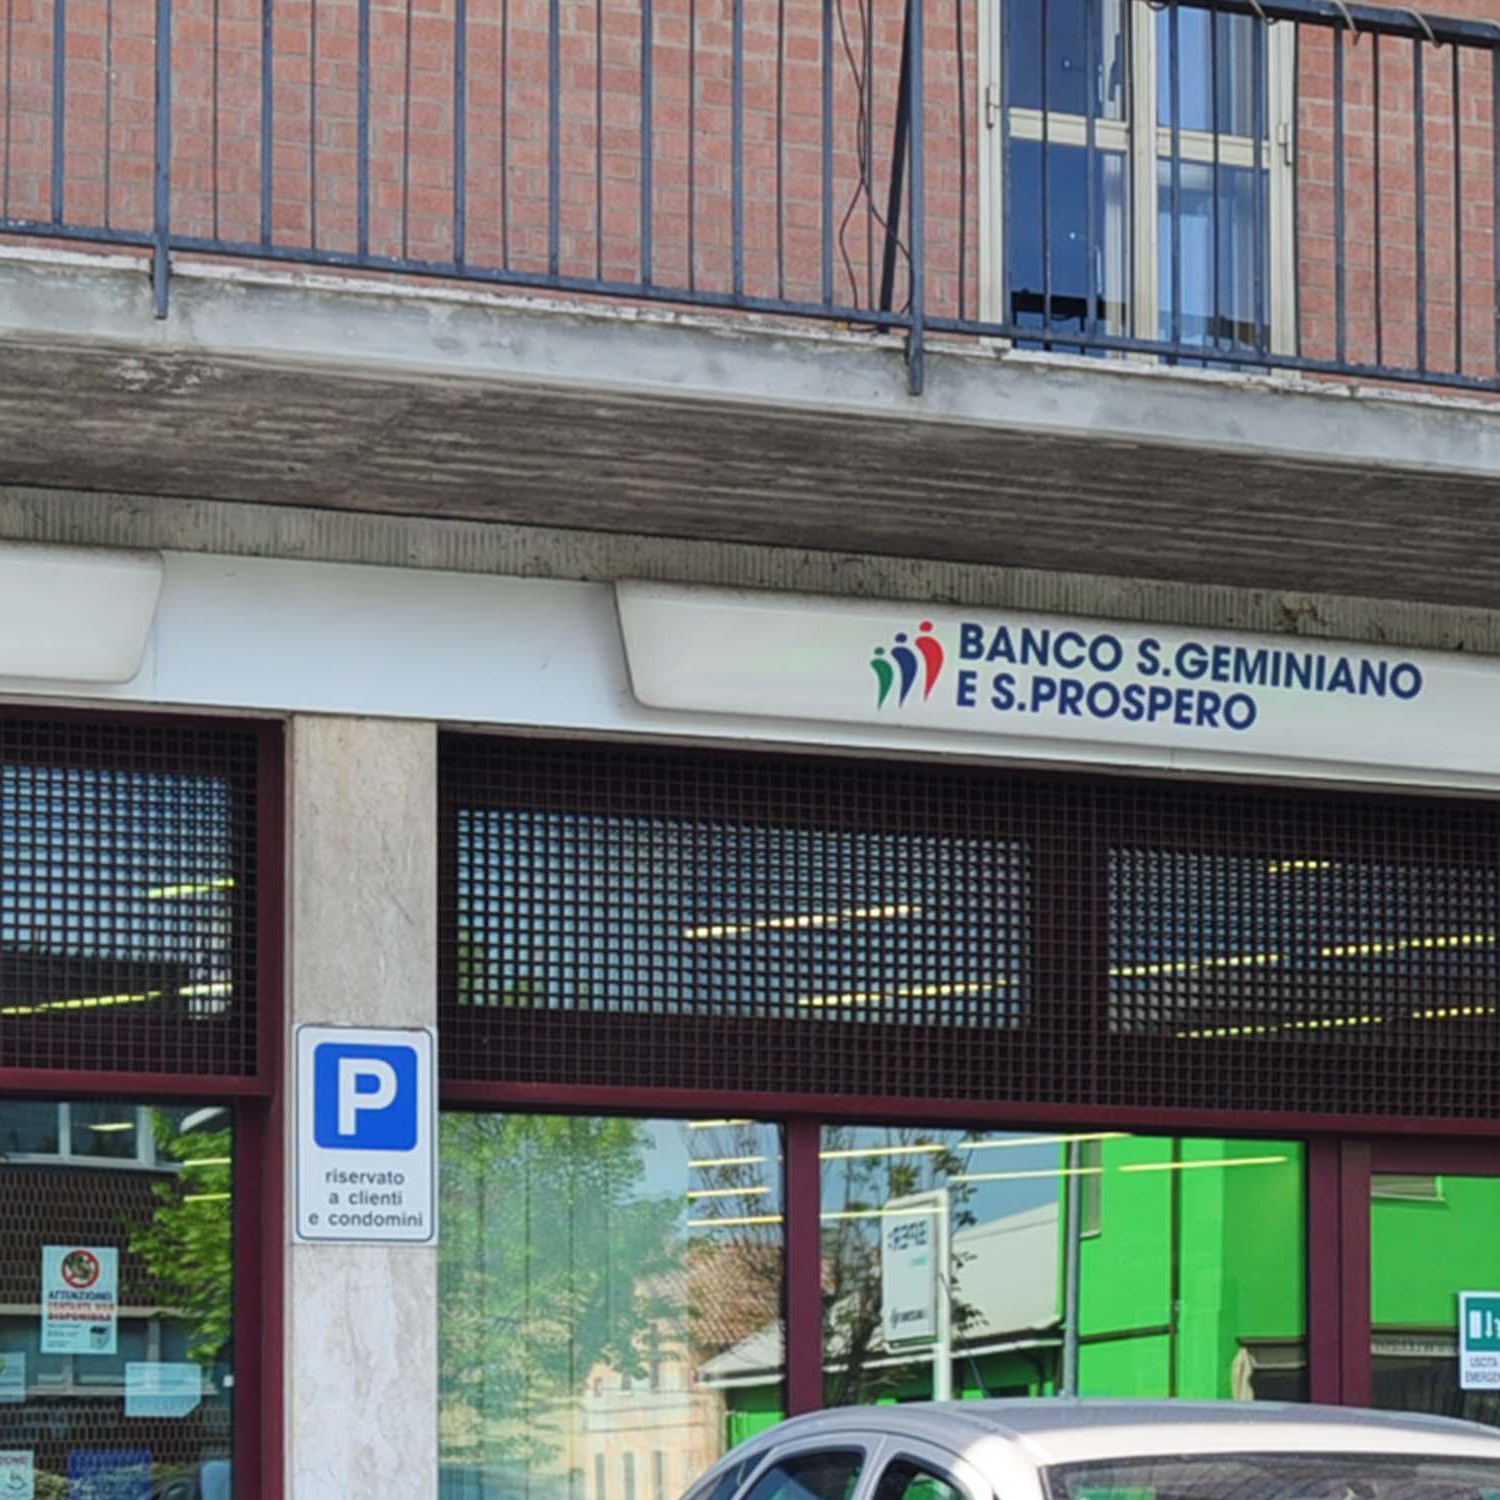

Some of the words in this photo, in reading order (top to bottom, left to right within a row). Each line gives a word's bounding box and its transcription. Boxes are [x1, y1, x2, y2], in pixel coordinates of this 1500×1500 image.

[959, 622, 1122, 671] BANCO
[1137, 637, 1423, 700] S.GEMINIANO
[957, 671, 977, 707] E
[991, 674, 1257, 730] S.PROSPERO
[338, 1057, 398, 1136] P
[324, 1168, 405, 1186] riservato
[328, 1192, 340, 1206] a
[348, 1190, 403, 1206] clienti
[308, 1212, 320, 1226] e
[328, 1211, 424, 1228] condomini
